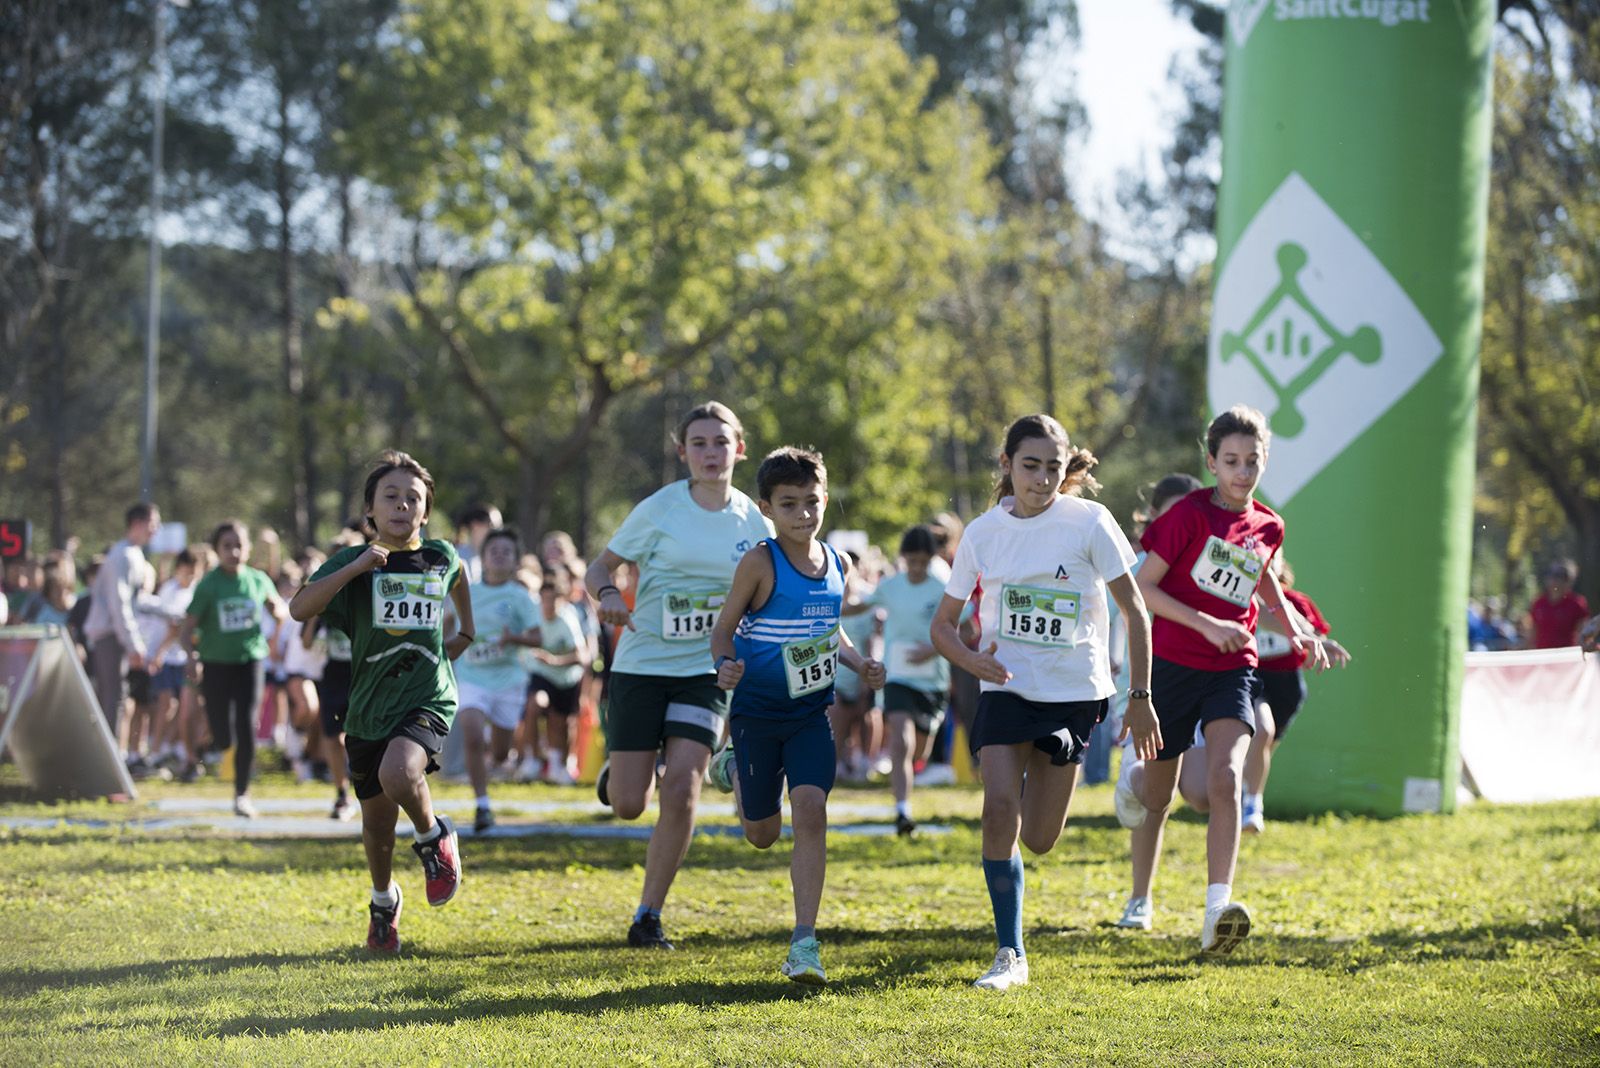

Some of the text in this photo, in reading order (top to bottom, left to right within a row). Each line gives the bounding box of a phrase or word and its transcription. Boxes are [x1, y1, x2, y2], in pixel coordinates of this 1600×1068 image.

[381, 582, 404, 594] CROS
[1211, 568, 1240, 592] 471
[1008, 595, 1032, 606] CROS
[384, 601, 432, 619] 2041
[802, 606, 834, 617] SABADELL
[673, 613, 714, 632] 1134
[1009, 613, 1062, 636] 1538
[792, 646, 816, 663] CROS
